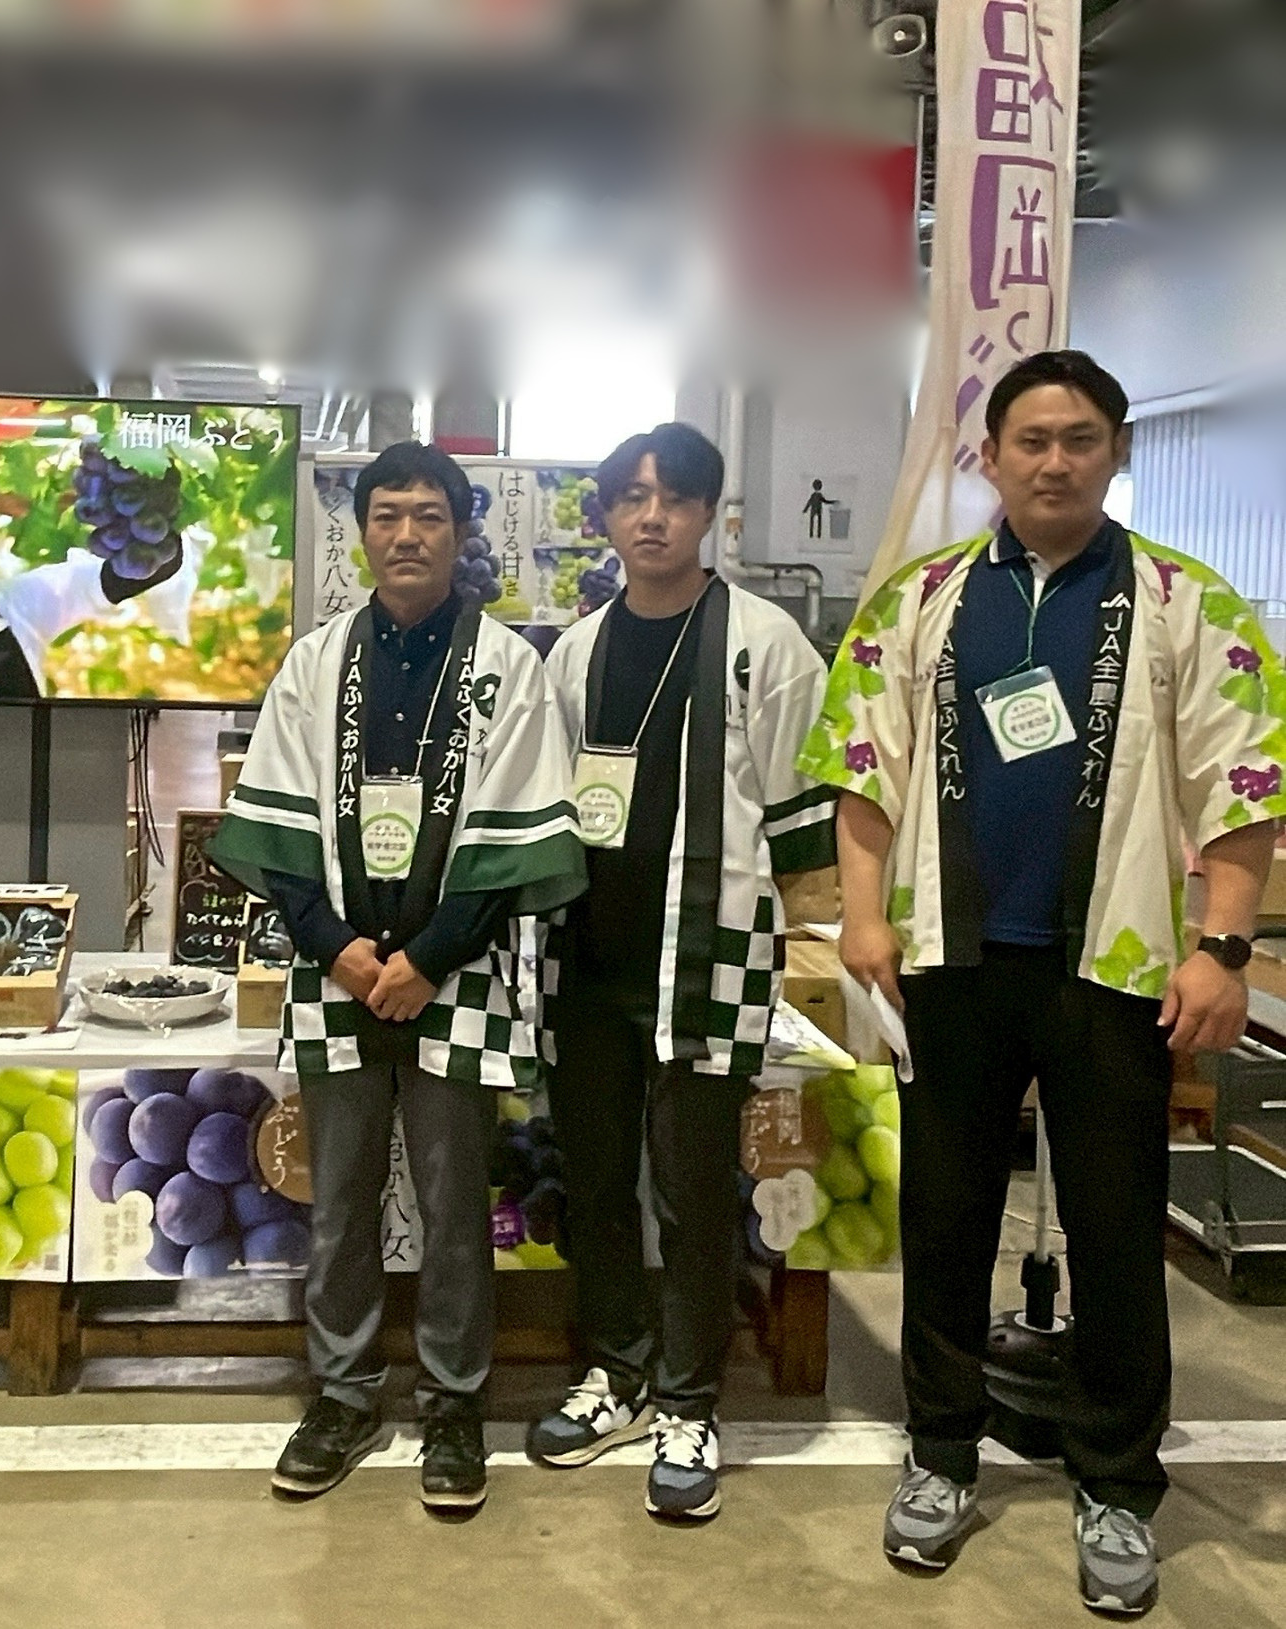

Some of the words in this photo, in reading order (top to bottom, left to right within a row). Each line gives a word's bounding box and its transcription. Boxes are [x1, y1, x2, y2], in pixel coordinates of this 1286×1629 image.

[119, 411, 284, 454] 福岡ぶどう
[498, 471, 525, 597] はじける甘さ
[338, 643, 363, 818] JAふくおか八女
[430, 645, 474, 816] JAふくおか八女
